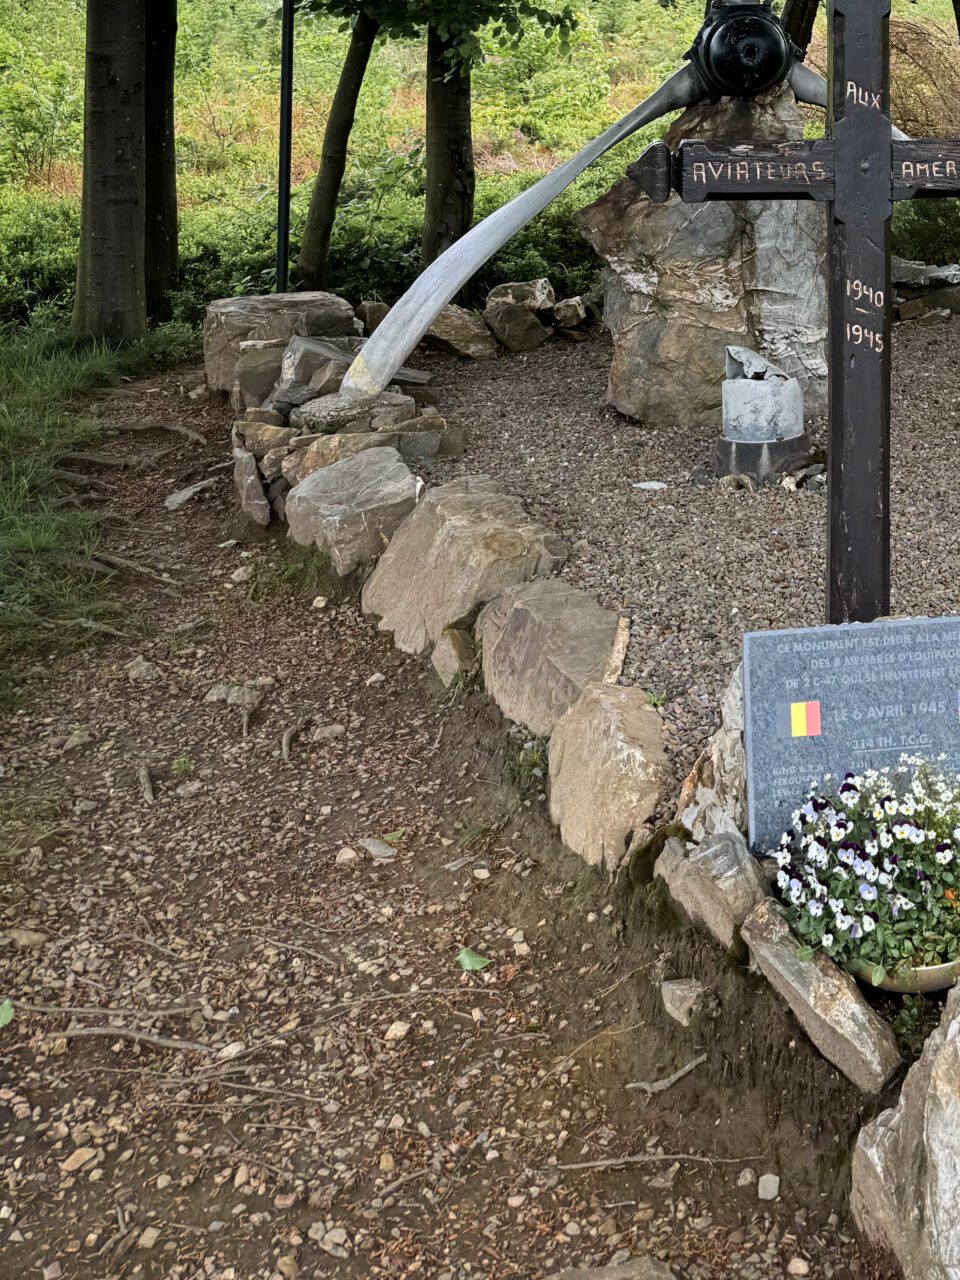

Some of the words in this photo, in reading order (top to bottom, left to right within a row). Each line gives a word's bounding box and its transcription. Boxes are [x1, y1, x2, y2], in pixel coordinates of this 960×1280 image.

[693, 161, 825, 184] AVIATEURS
[846, 279, 884, 308] 1940
[846, 322, 884, 353] 1945
[776, 642, 790, 654] CE
[792, 638, 860, 653] MONUMENT
[862, 637, 880, 648] EST
[926, 632, 940, 643] LA
[811, 658, 831, 669] DES
[844, 652, 896, 667] MEMBRES
[785, 679, 800, 689] DE
[804, 678, 811, 688] 2
[841, 673, 862, 685] QUI
[864, 673, 878, 683] SE
[833, 708, 850, 722] LE
[852, 707, 863, 721] 6
[867, 704, 907, 719] AVRIL
[911, 700, 946, 716] 1945
[852, 738, 875, 750] 314
[899, 733, 932, 746] T.C.G.
[772, 766, 797, 776] KING
